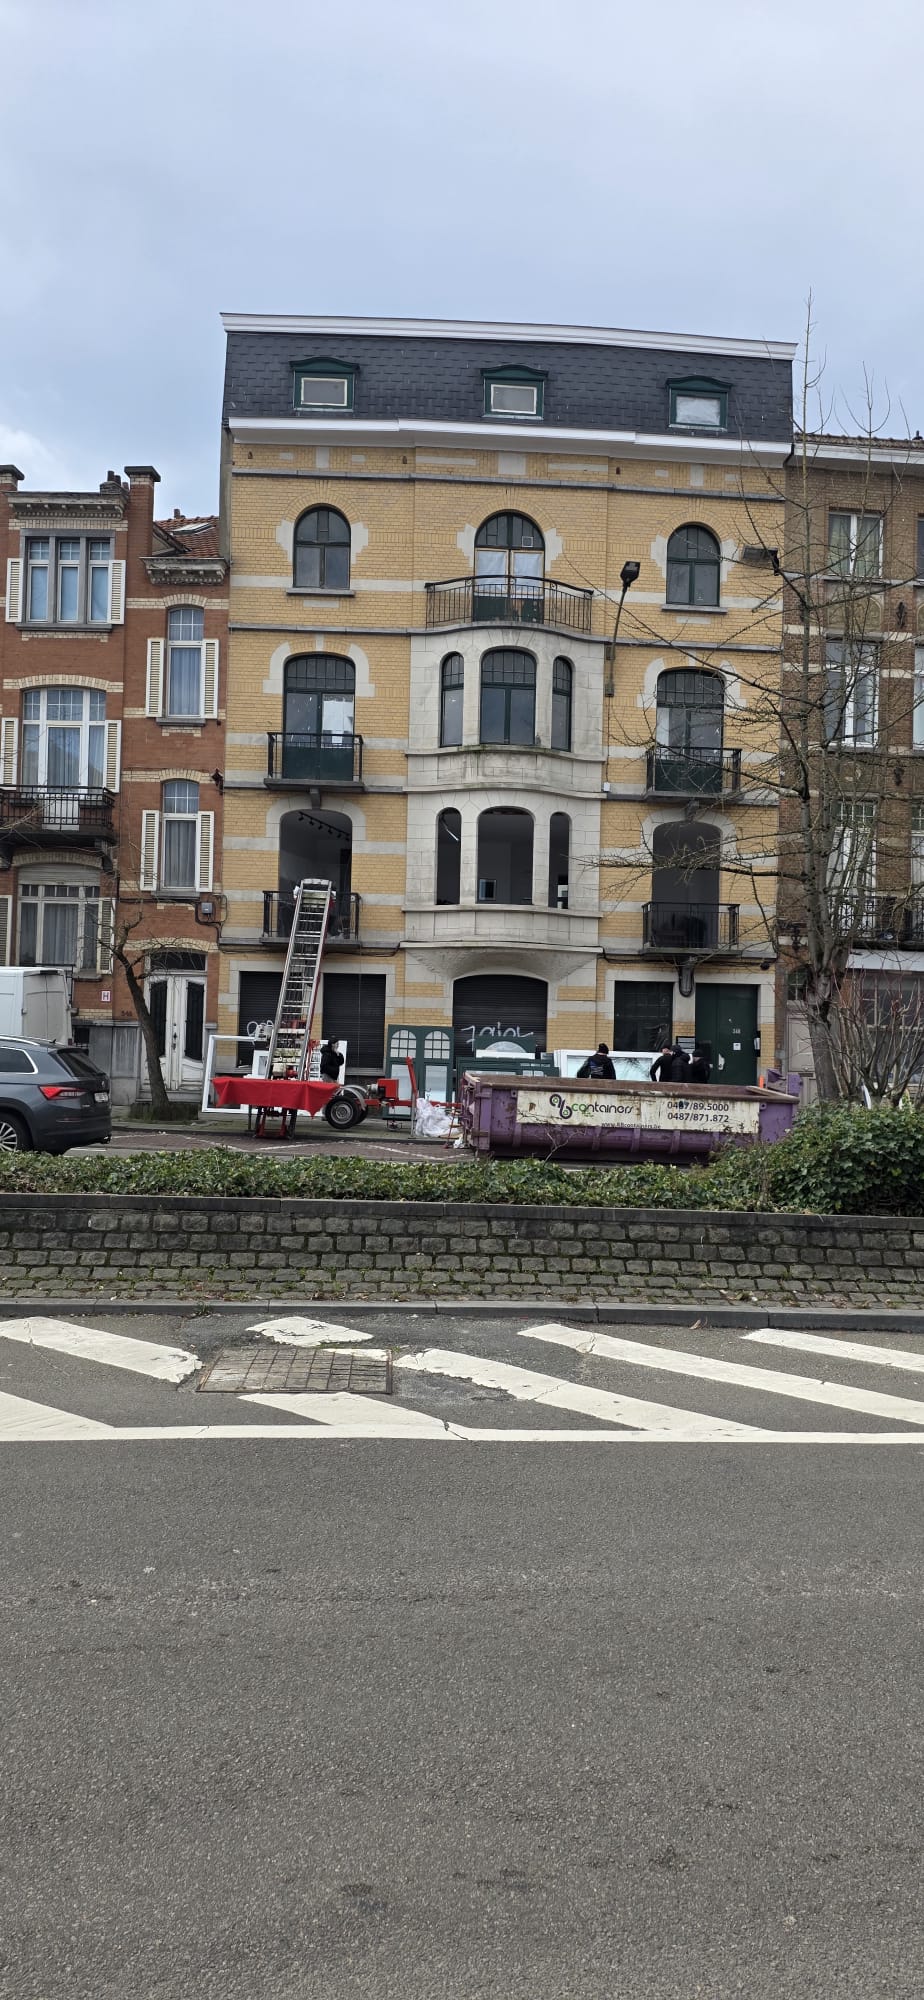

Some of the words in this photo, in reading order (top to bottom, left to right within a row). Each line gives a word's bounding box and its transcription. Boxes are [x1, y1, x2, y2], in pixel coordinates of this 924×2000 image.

[571, 1101, 634, 1114] containers
[667, 1100, 729, 1112] 0487/89.5000
[667, 1112, 729, 1123] 0487/871.872
